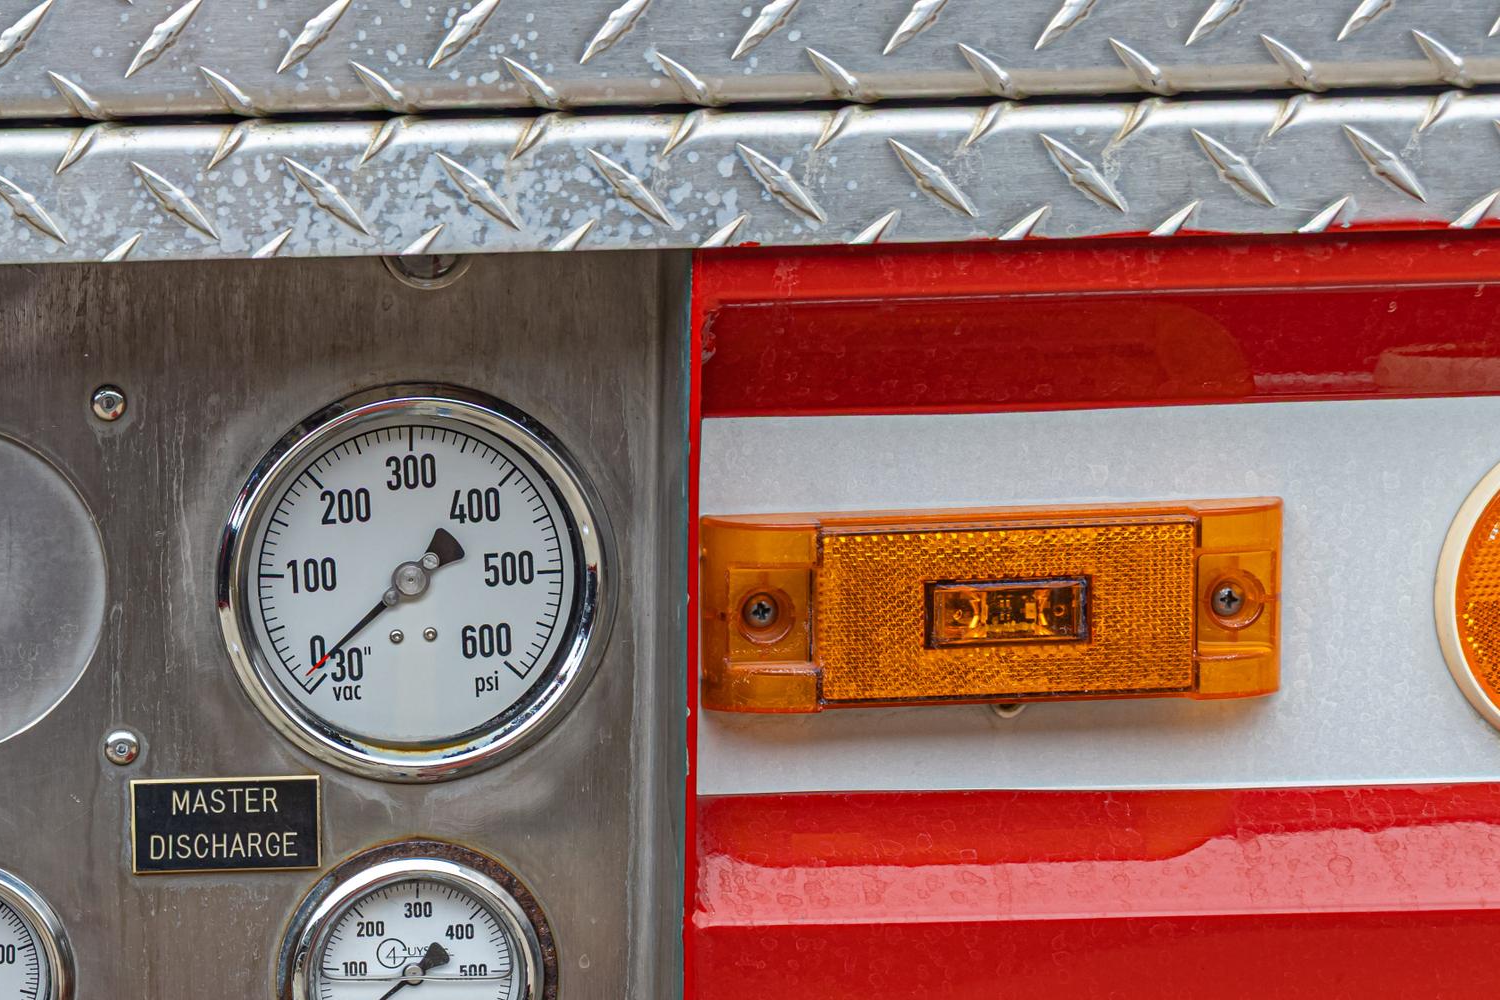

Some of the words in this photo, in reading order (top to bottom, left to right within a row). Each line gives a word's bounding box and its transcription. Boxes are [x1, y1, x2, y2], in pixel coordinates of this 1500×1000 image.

[386, 453, 436, 490] 300
[320, 488, 371, 524] 200
[450, 487, 500, 524] 400
[287, 557, 337, 594] 100
[484, 550, 534, 587] 500
[310, 635, 326, 669] 0
[462, 622, 512, 659] 600
[332, 684, 362, 701] vac
[475, 671, 499, 697] psi
[172, 788, 278, 815] MASTER
[150, 832, 298, 860] DISCHARGE
[404, 902, 432, 918] 300
[357, 921, 384, 937] 200
[446, 924, 474, 940] 400
[343, 962, 367, 976] 100
[460, 964, 487, 976] 500
